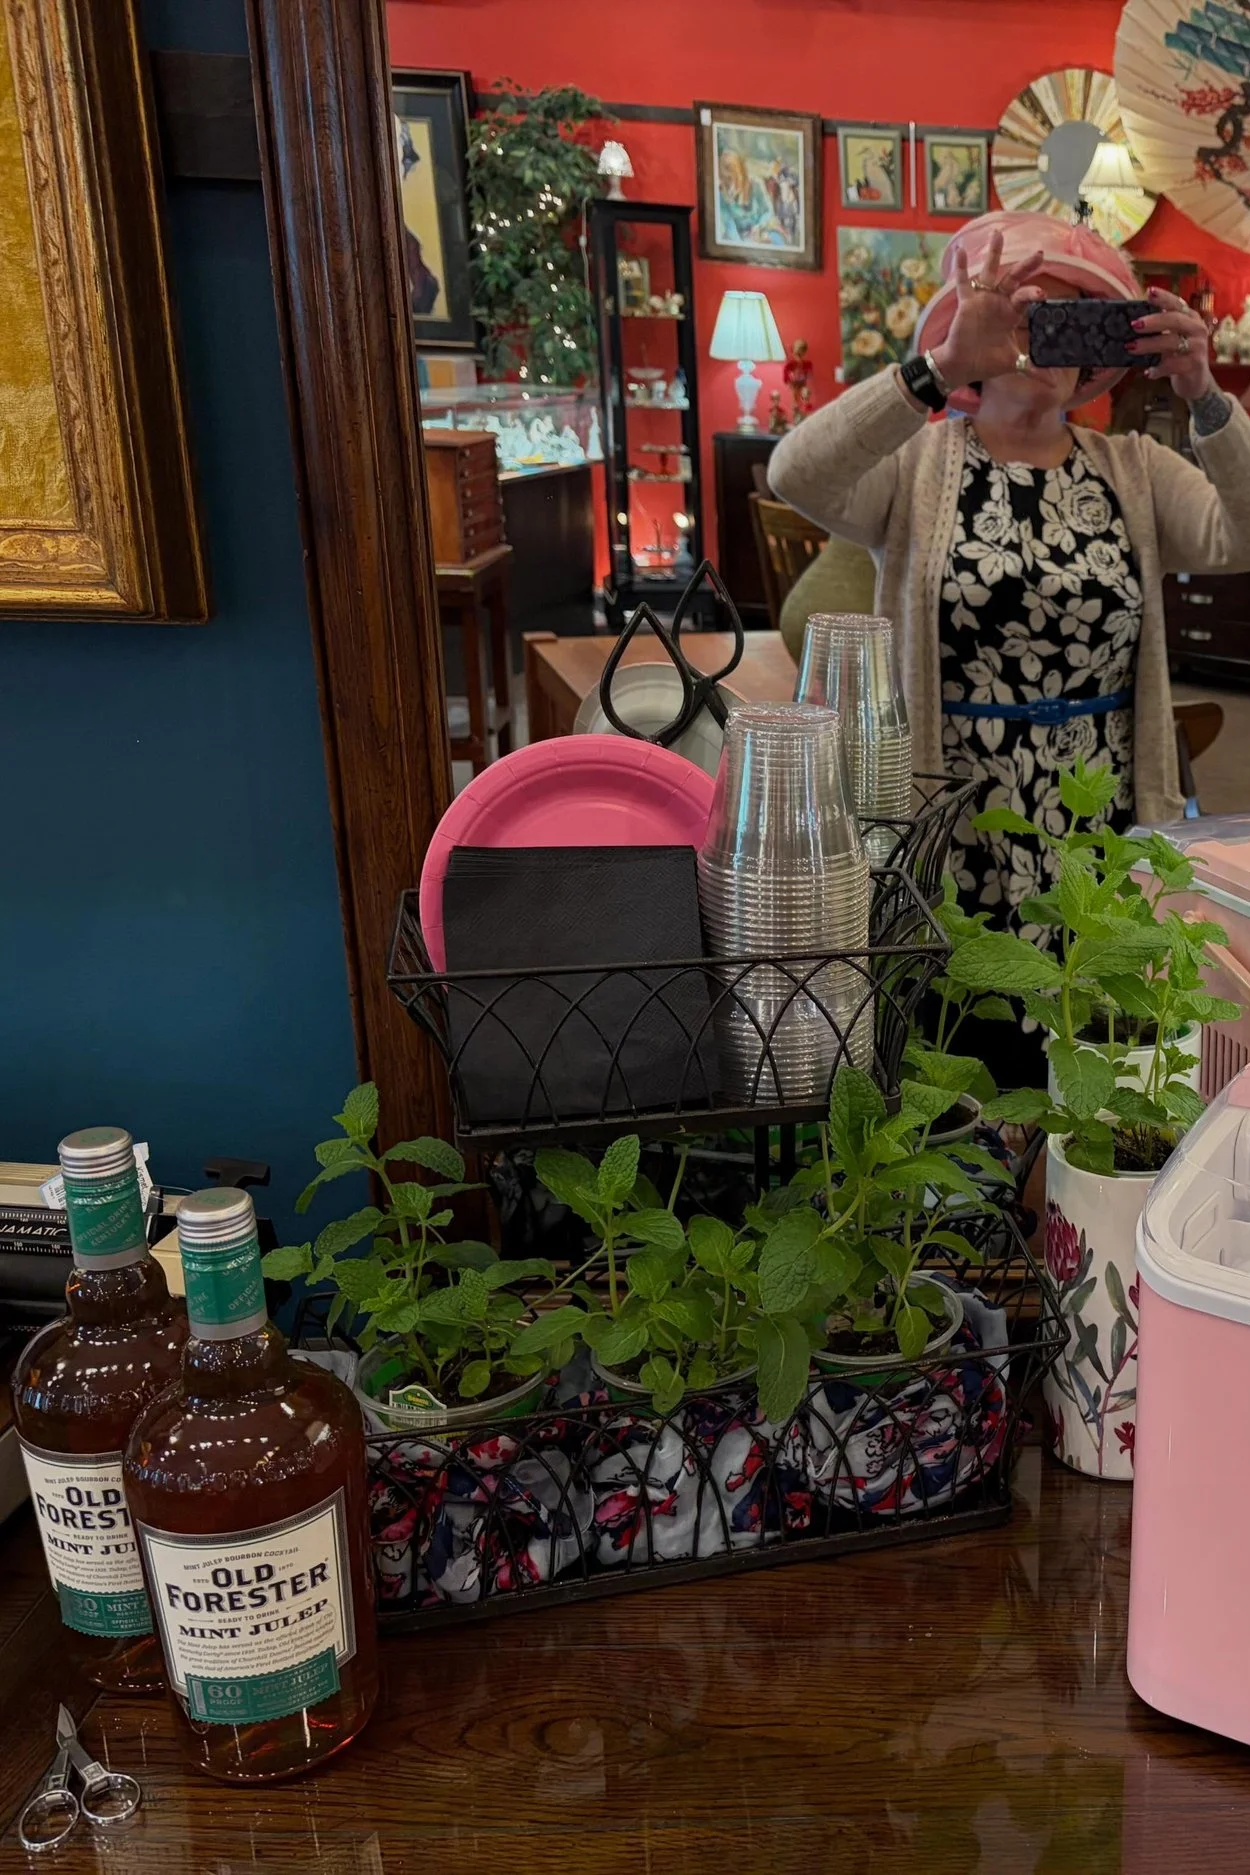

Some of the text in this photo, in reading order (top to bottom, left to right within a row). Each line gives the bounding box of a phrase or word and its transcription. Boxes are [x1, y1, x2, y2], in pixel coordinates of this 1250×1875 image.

[66, 1486, 122, 1507] OLD
[36, 1492, 130, 1530] FOREST
[46, 1531, 93, 1555] MINT
[202, 1558, 223, 1569] JULEP
[225, 1552, 263, 1563] BOURBON
[264, 1547, 299, 1557] COCKTAIL
[211, 1563, 274, 1588] OLD
[165, 1564, 328, 1613] FORESTER
[179, 1624, 241, 1639] MINT
[249, 1598, 329, 1636] JULEP
[218, 1616, 242, 1624] READY
[256, 1609, 280, 1620] DRINK
[207, 1684, 242, 1698] 60
